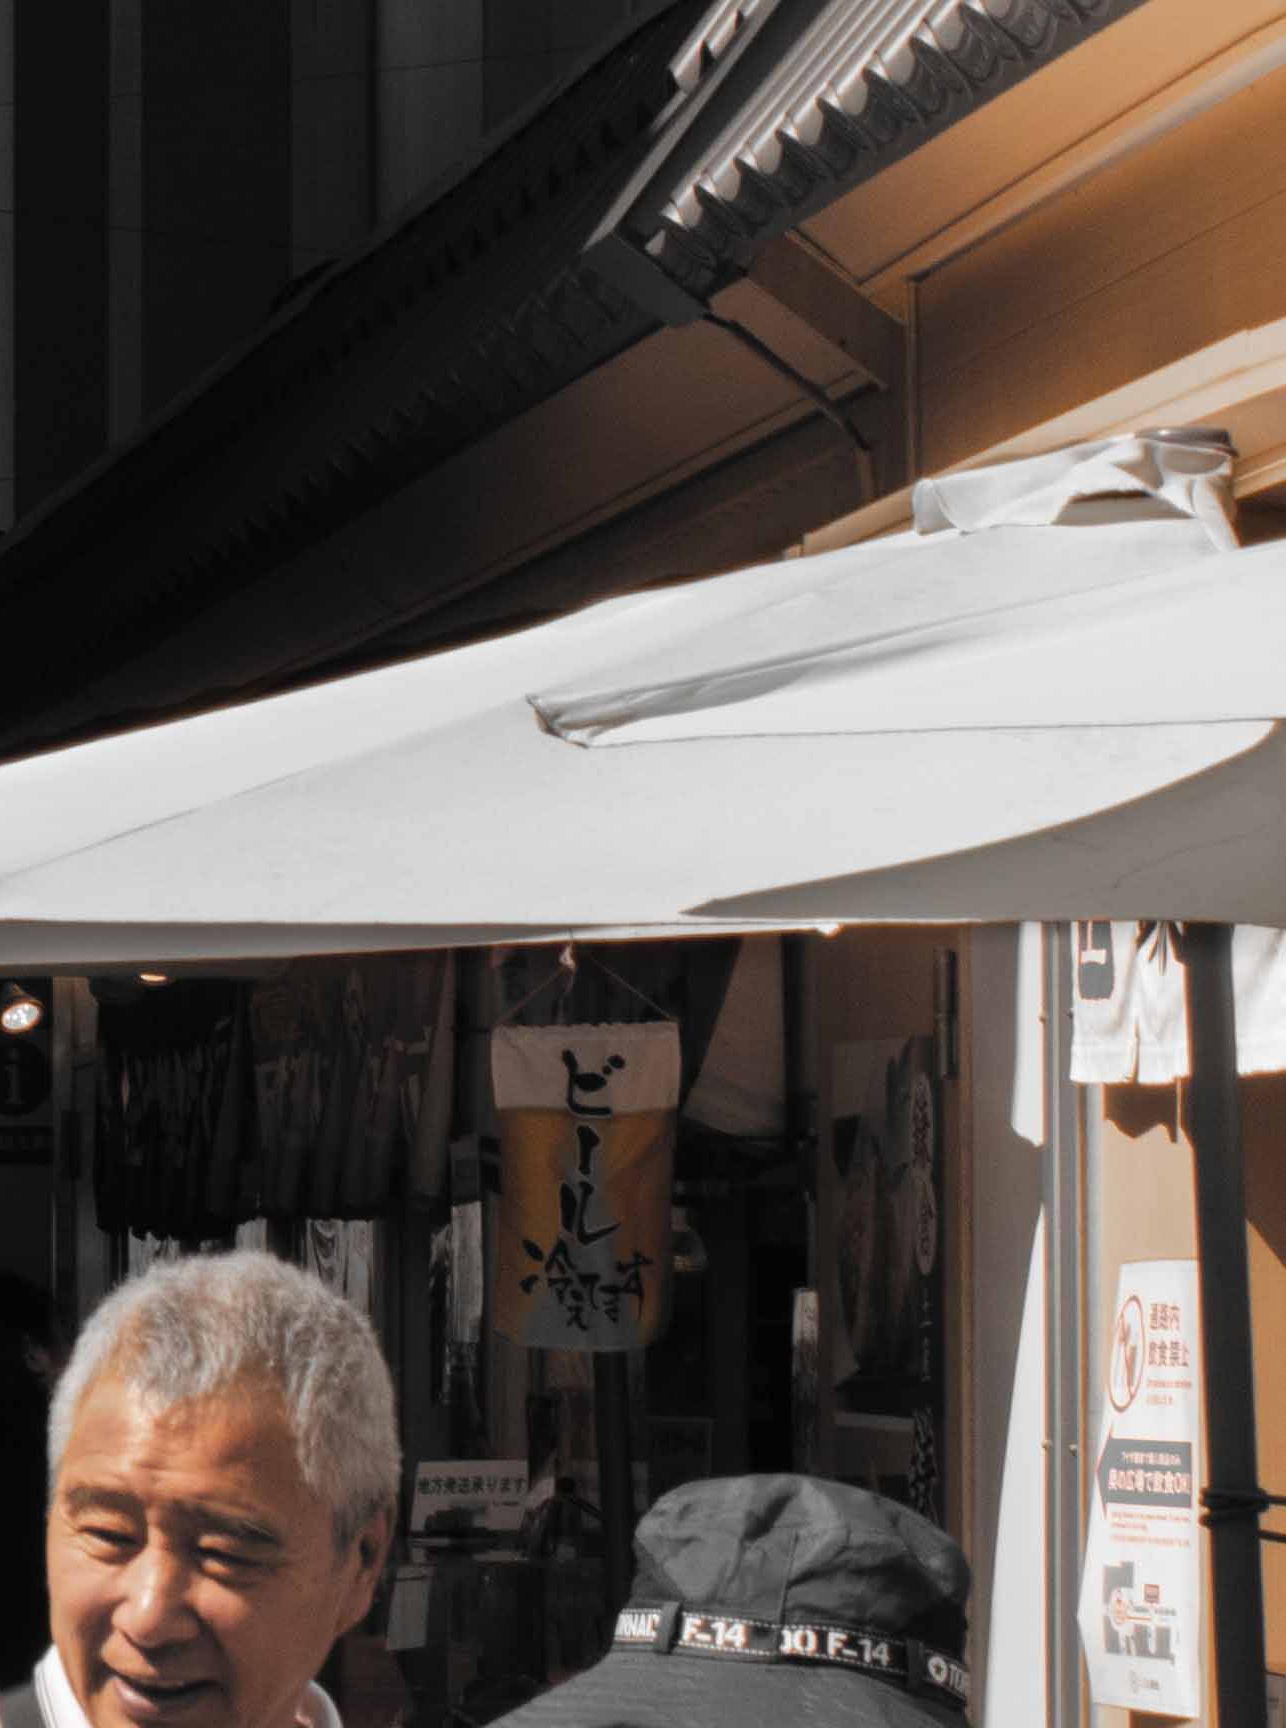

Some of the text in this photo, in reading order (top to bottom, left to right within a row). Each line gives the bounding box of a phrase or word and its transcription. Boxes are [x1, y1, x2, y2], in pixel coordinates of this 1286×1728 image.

[559, 1048, 626, 1247] ビール
[682, 1616, 747, 1649] F-14
[827, 1635, 890, 1667] F-14
